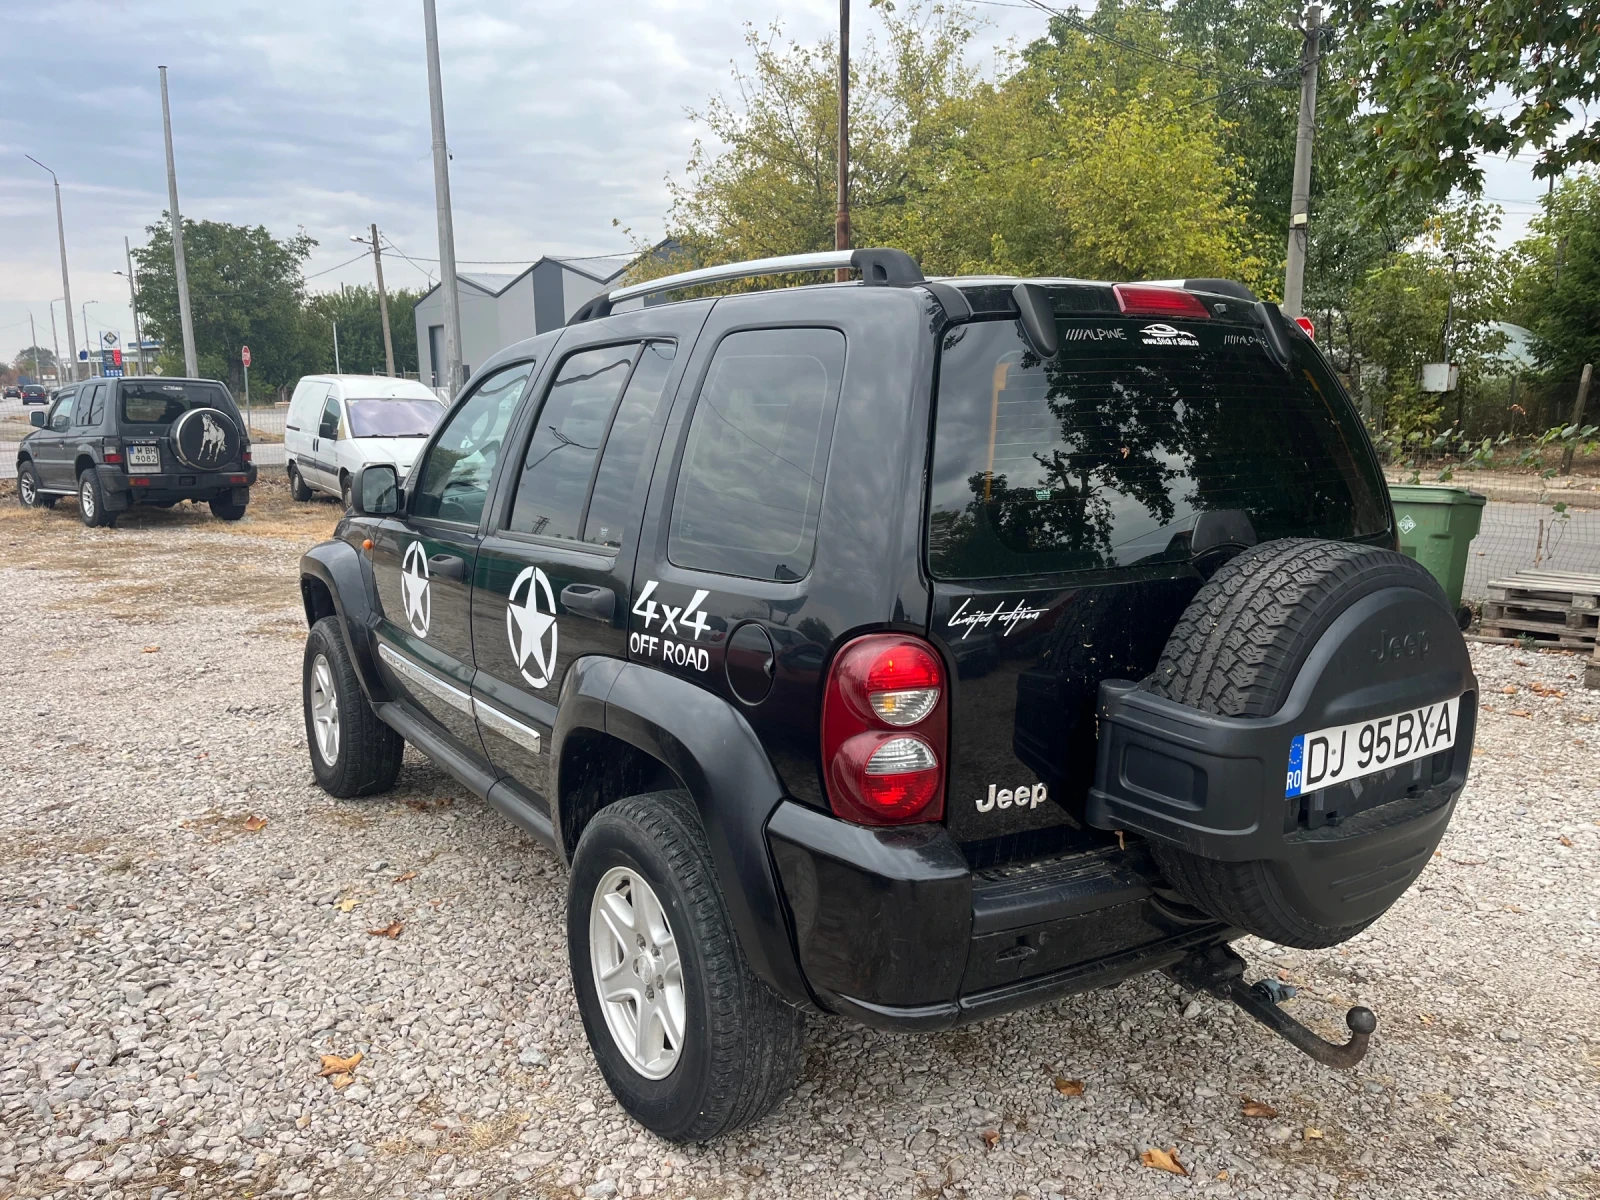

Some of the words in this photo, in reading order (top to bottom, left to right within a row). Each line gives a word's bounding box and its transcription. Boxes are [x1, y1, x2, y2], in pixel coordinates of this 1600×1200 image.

[1083, 328, 1127, 341] ALPINE
[135, 455, 157, 463] 9082
[145, 446, 157, 455] BH
[631, 579, 712, 641] 4x4
[998, 598, 1050, 637] edition
[630, 631, 659, 657] OFF
[663, 639, 710, 672] ROAD
[1370, 628, 1433, 664] Jeep
[1305, 730, 1347, 787] DJ
[1356, 702, 1452, 770] 95BXA
[1285, 769, 1302, 791] RO
[975, 782, 1049, 813] Jeep
